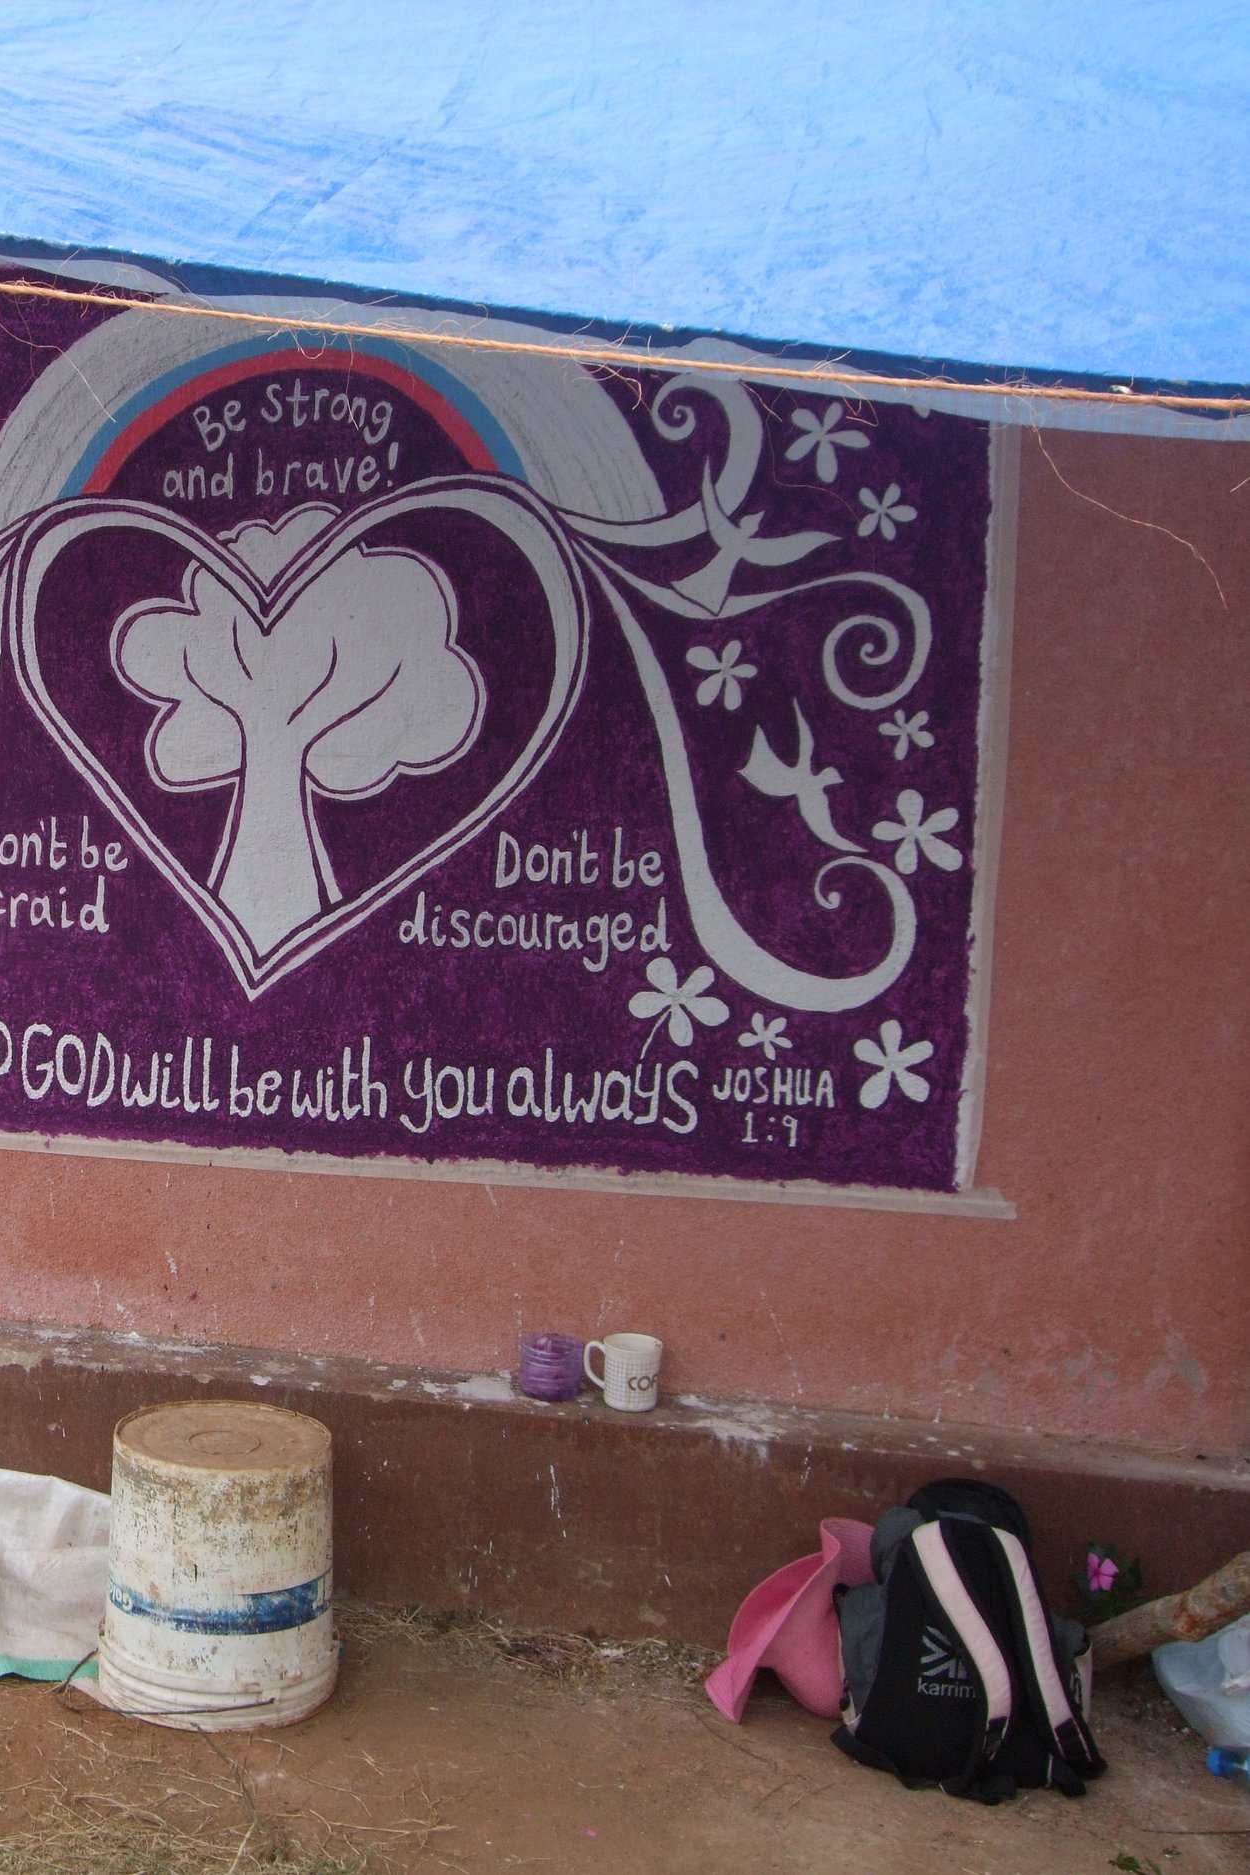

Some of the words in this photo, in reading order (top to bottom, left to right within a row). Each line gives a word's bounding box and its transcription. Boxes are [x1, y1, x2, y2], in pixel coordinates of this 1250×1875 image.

[192, 399, 246, 453] Be
[162, 453, 234, 500] and
[256, 442, 399, 496] brave!
[81, 816, 129, 871] be
[495, 828, 599, 888] Don't
[612, 826, 665, 888] be
[399, 890, 672, 972] discouraged
[21, 1023, 116, 1107] GOD
[120, 1036, 220, 1113] will
[230, 1045, 282, 1116] be
[291, 1036, 387, 1122] with
[399, 1057, 494, 1134] you
[713, 1066, 835, 1109] JOSHUA
[741, 1111, 798, 1148] 1:9
